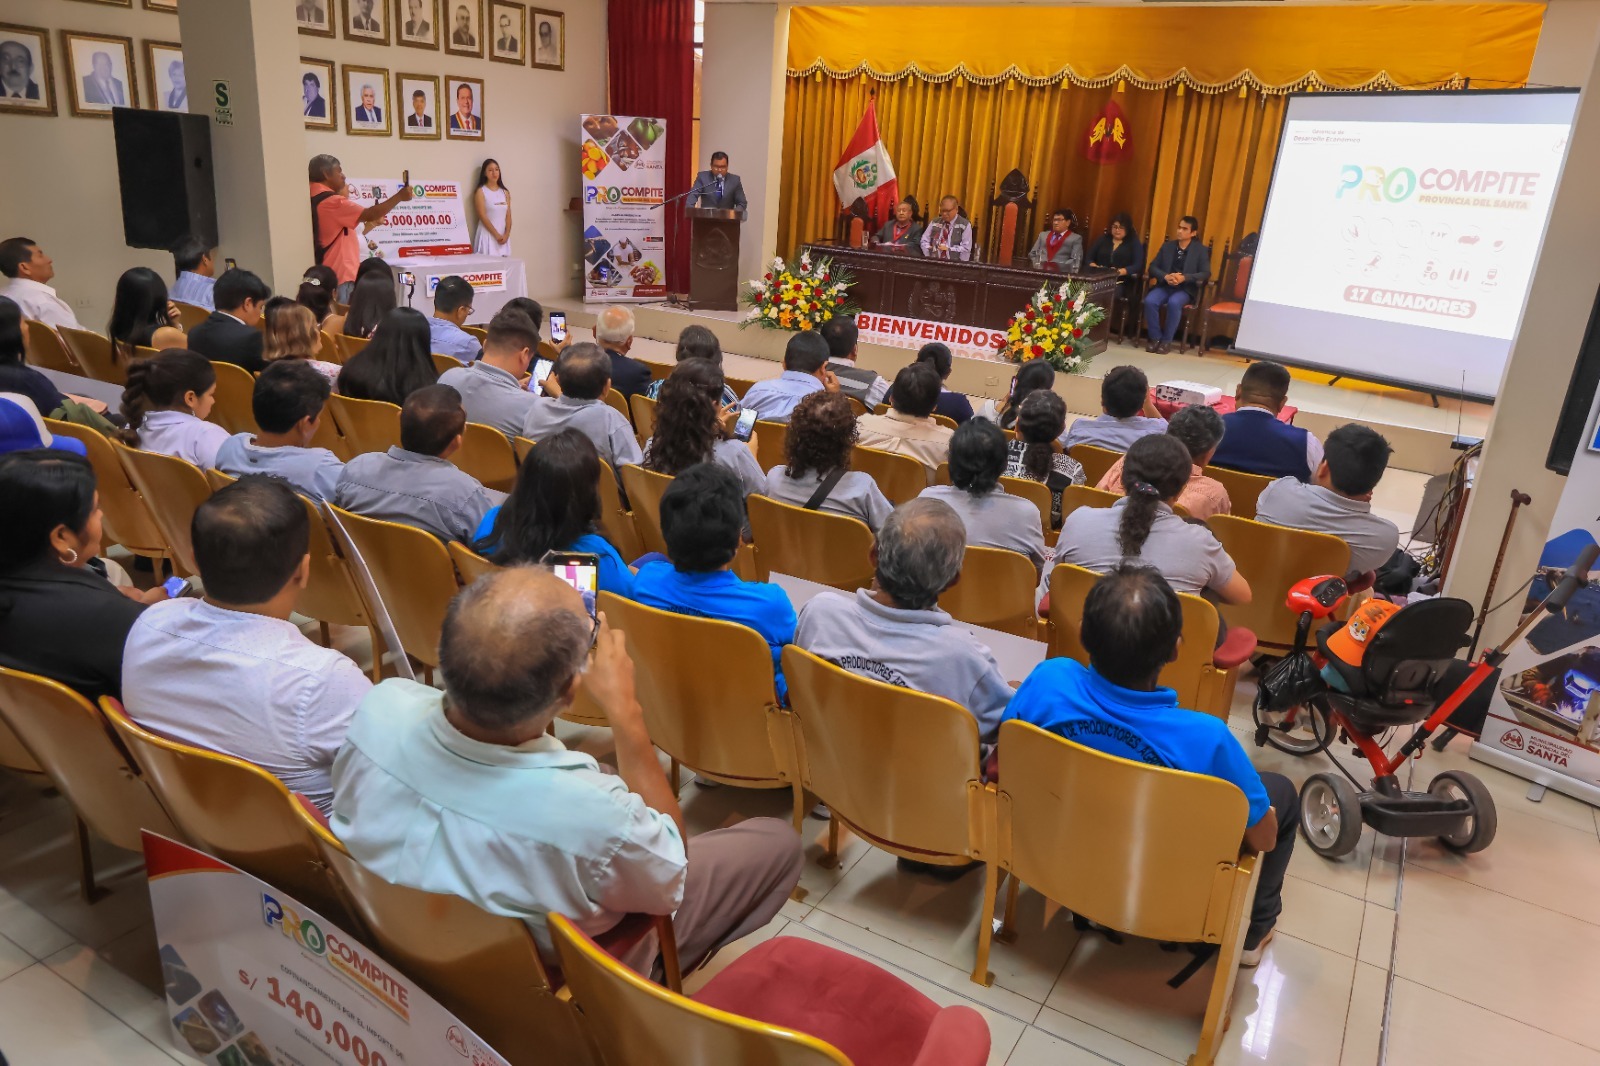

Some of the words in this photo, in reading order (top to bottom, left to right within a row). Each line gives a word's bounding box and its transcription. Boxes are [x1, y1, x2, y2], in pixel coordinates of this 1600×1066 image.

[215, 82, 229, 107] S
[424, 184, 457, 193] COMPITE
[585, 185, 621, 204] PRO
[620, 186, 664, 198] COMPITE
[1335, 164, 1417, 203] PRO
[1419, 167, 1541, 196] COMPITE
[1418, 194, 1471, 207] PROVINCIA
[1472, 198, 1492, 208] DEL
[1493, 199, 1528, 210] SANTA
[1349, 287, 1371, 302] 17
[1371, 289, 1471, 316] GANADORES
[857, 314, 1005, 349] BIENVENIDOS
[841, 655, 894, 681] PRODUCTORES
[1079, 719, 1142, 750] PRODUCTORES
[1526, 745, 1568, 768] SANTA
[263, 893, 326, 955] PRO
[325, 934, 409, 1009] COMPITE
